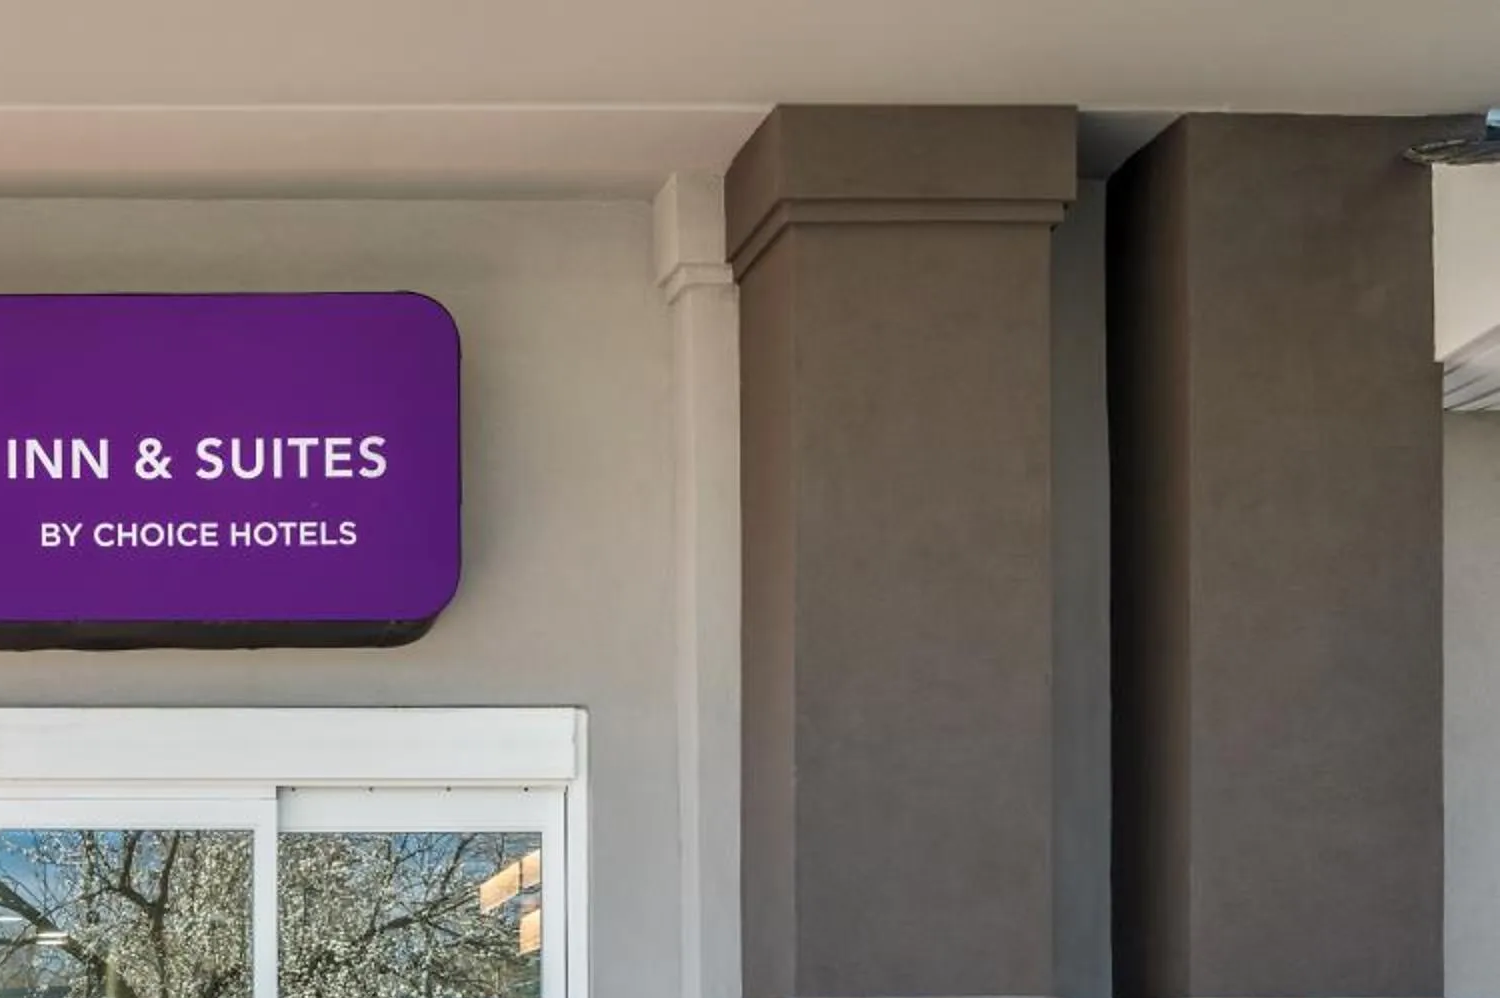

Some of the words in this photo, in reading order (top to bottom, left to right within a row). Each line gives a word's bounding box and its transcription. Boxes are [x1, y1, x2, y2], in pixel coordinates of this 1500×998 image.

[7, 438, 109, 479] INN
[135, 437, 173, 480] &
[195, 435, 387, 480] SUITES
[41, 522, 83, 547] BY
[93, 522, 219, 547] CHOICE
[230, 521, 358, 547] HOTELS
